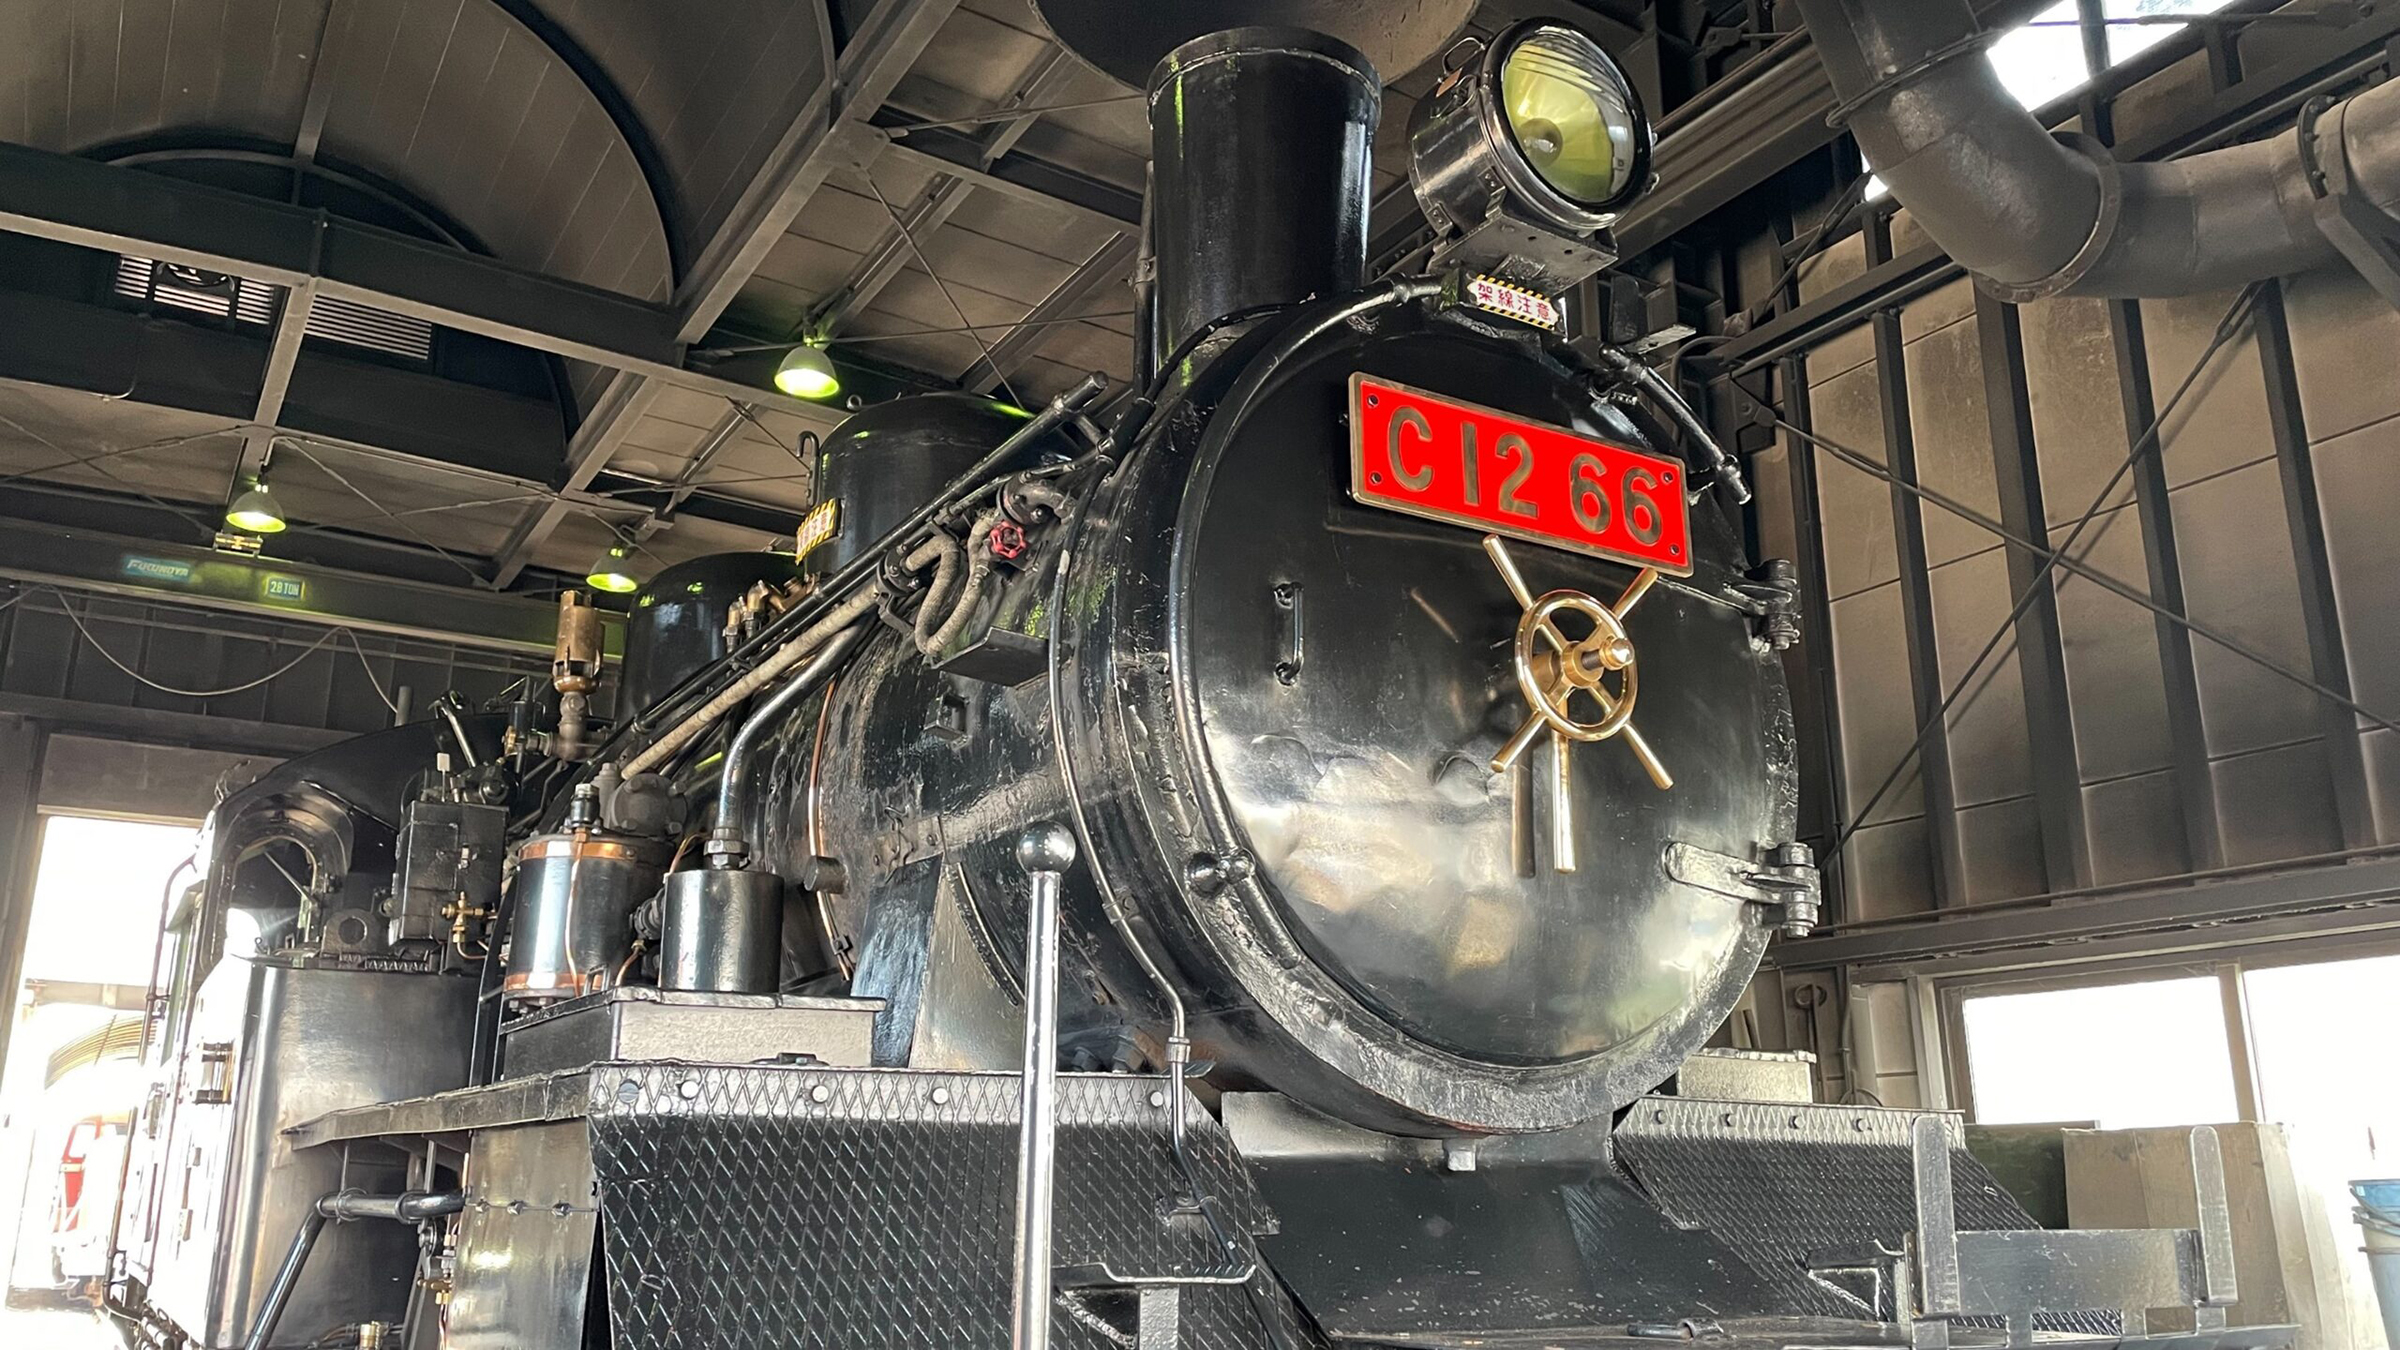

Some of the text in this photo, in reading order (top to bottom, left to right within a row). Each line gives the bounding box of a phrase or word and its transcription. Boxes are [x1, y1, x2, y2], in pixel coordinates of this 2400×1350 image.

[1478, 282, 1551, 321] 架線注意
[1569, 452, 1663, 547] 66
[284, 582, 300, 596] TON
